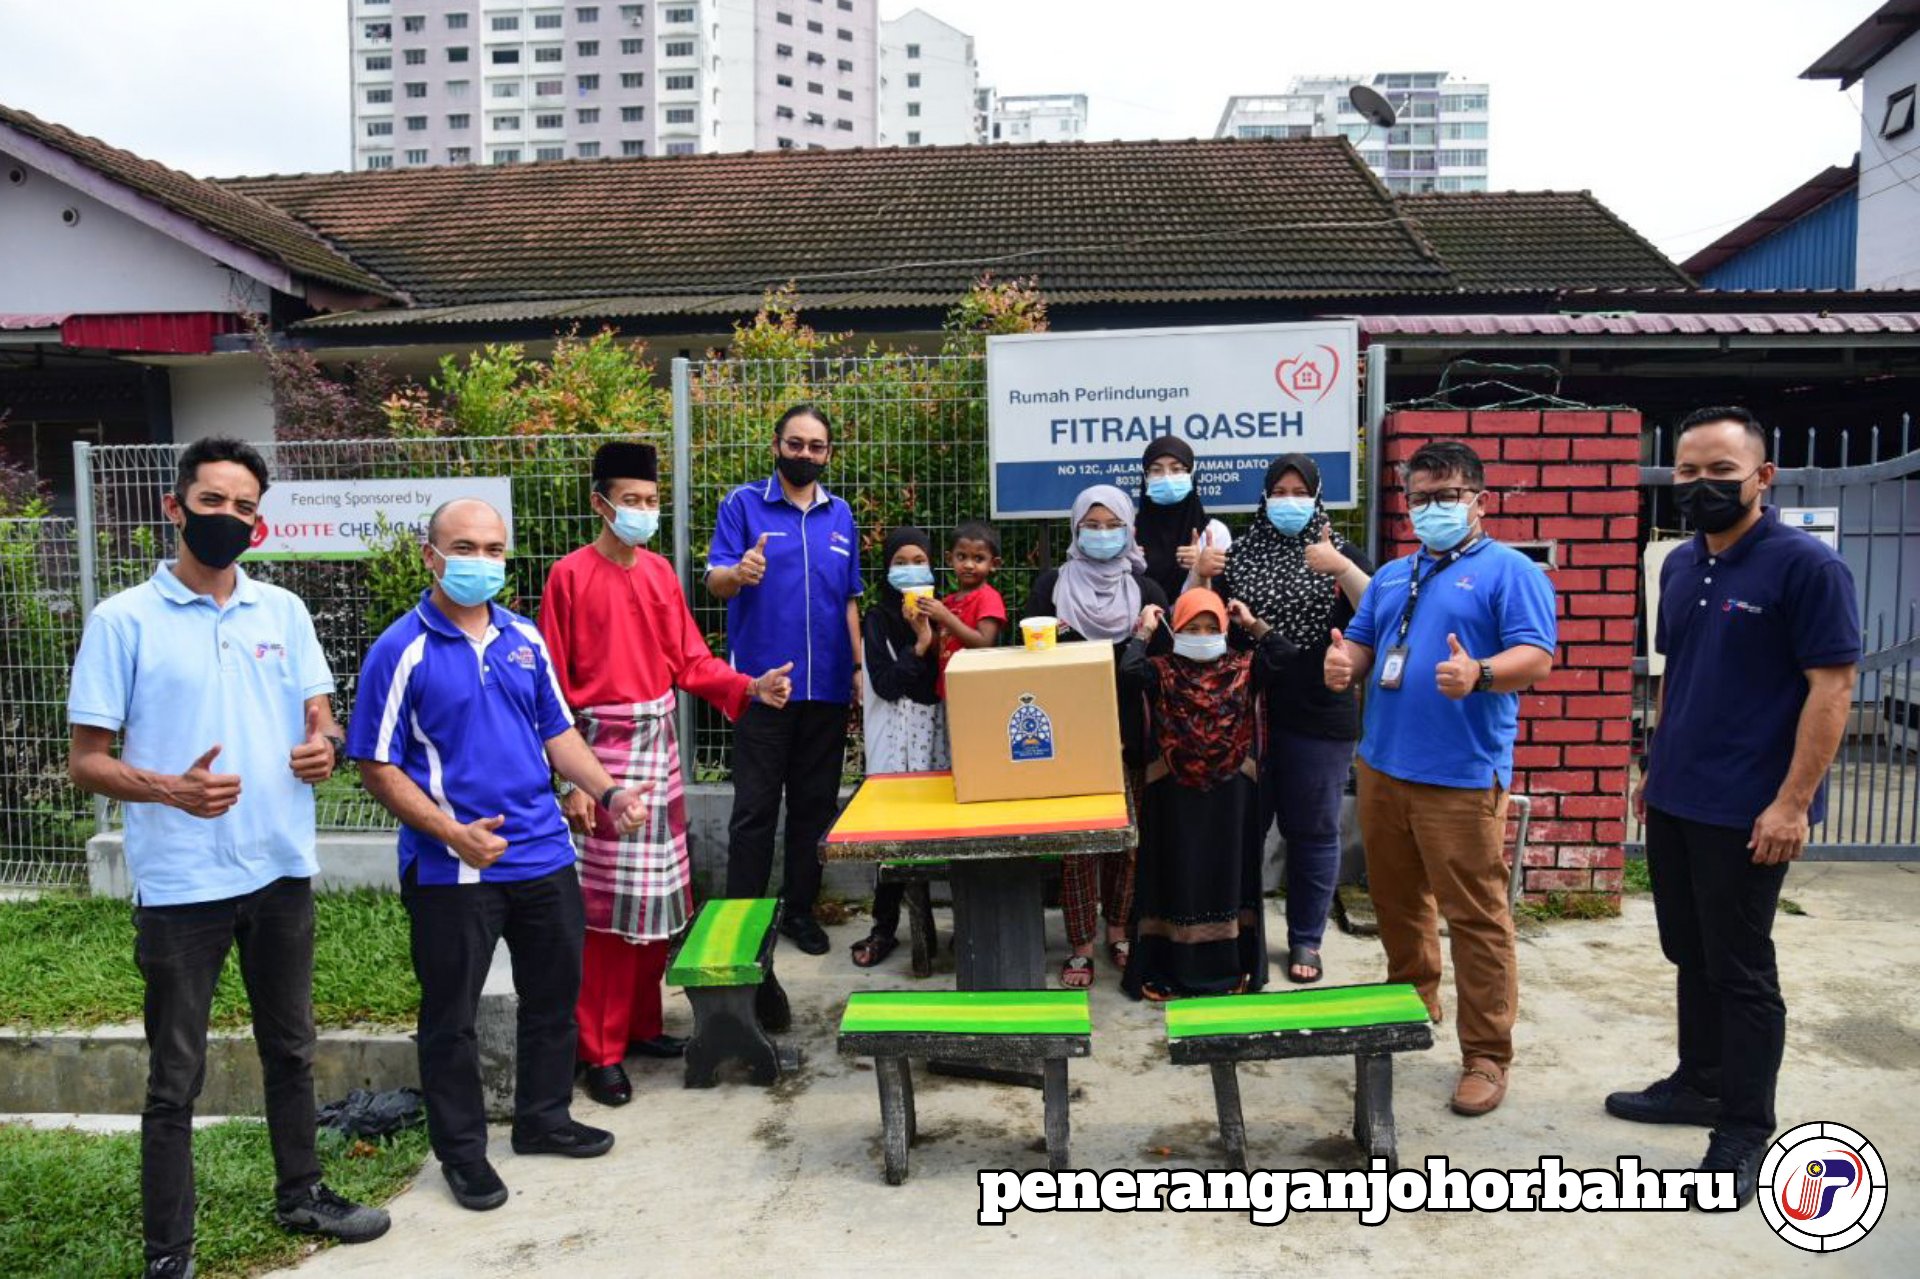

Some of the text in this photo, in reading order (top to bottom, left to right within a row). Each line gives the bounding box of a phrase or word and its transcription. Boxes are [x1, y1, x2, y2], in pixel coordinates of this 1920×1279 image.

[1009, 386, 1189, 404] Rumah Perlindungan
[1050, 411, 1303, 444] FITRAH QASEH
[1057, 465, 1077, 476] NO
[1079, 464, 1103, 476] 12C,
[1105, 463, 1144, 475] JALAN
[1115, 471, 1240, 487] 8035 JOHOR
[291, 491, 432, 508] Fencing Sponsored by
[274, 523, 333, 538] LOTTE
